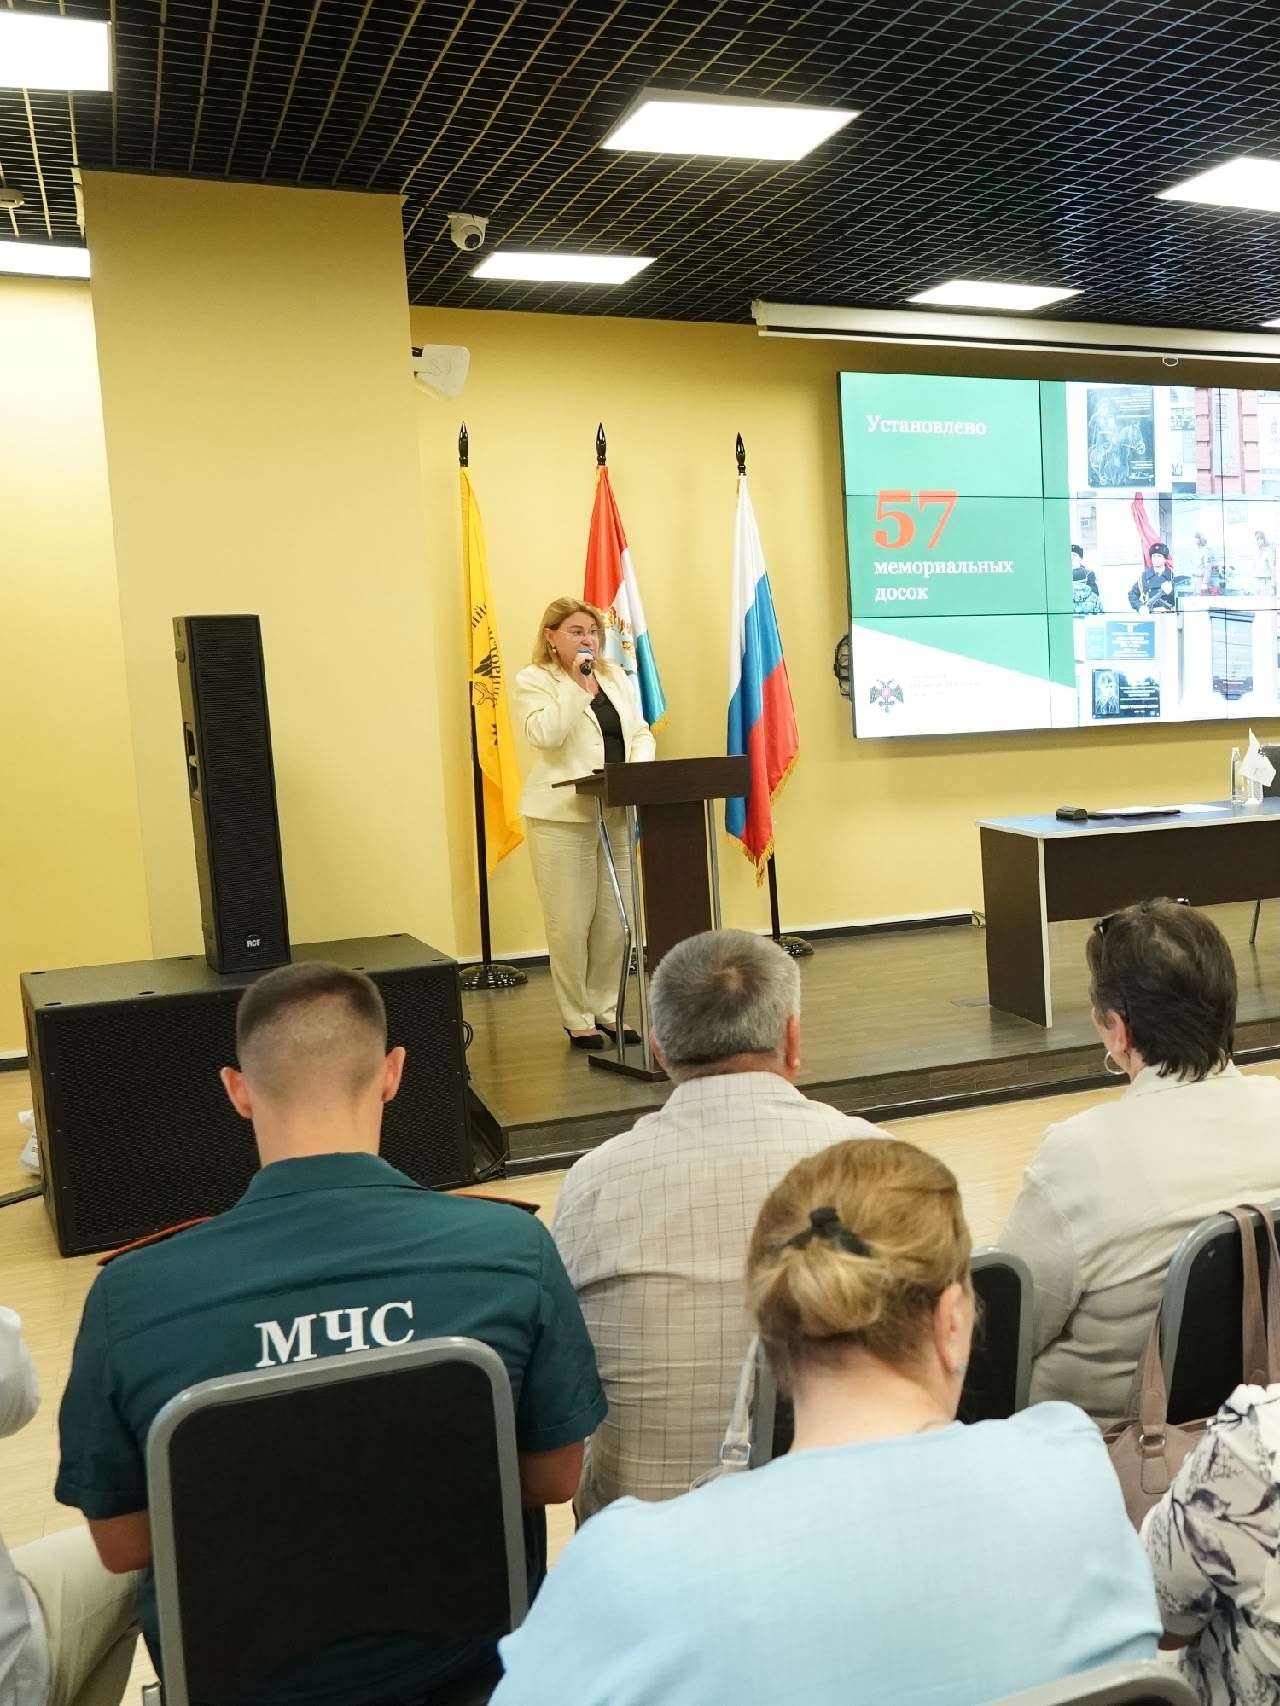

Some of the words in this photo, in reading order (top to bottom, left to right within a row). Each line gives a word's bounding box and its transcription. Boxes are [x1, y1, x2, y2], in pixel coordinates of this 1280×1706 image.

[865, 414, 987, 436] Установлено
[873, 489, 958, 550] 57
[874, 560, 1014, 578] мемориальных
[875, 587, 929, 603] досок
[254, 1300, 414, 1367] МЧС
